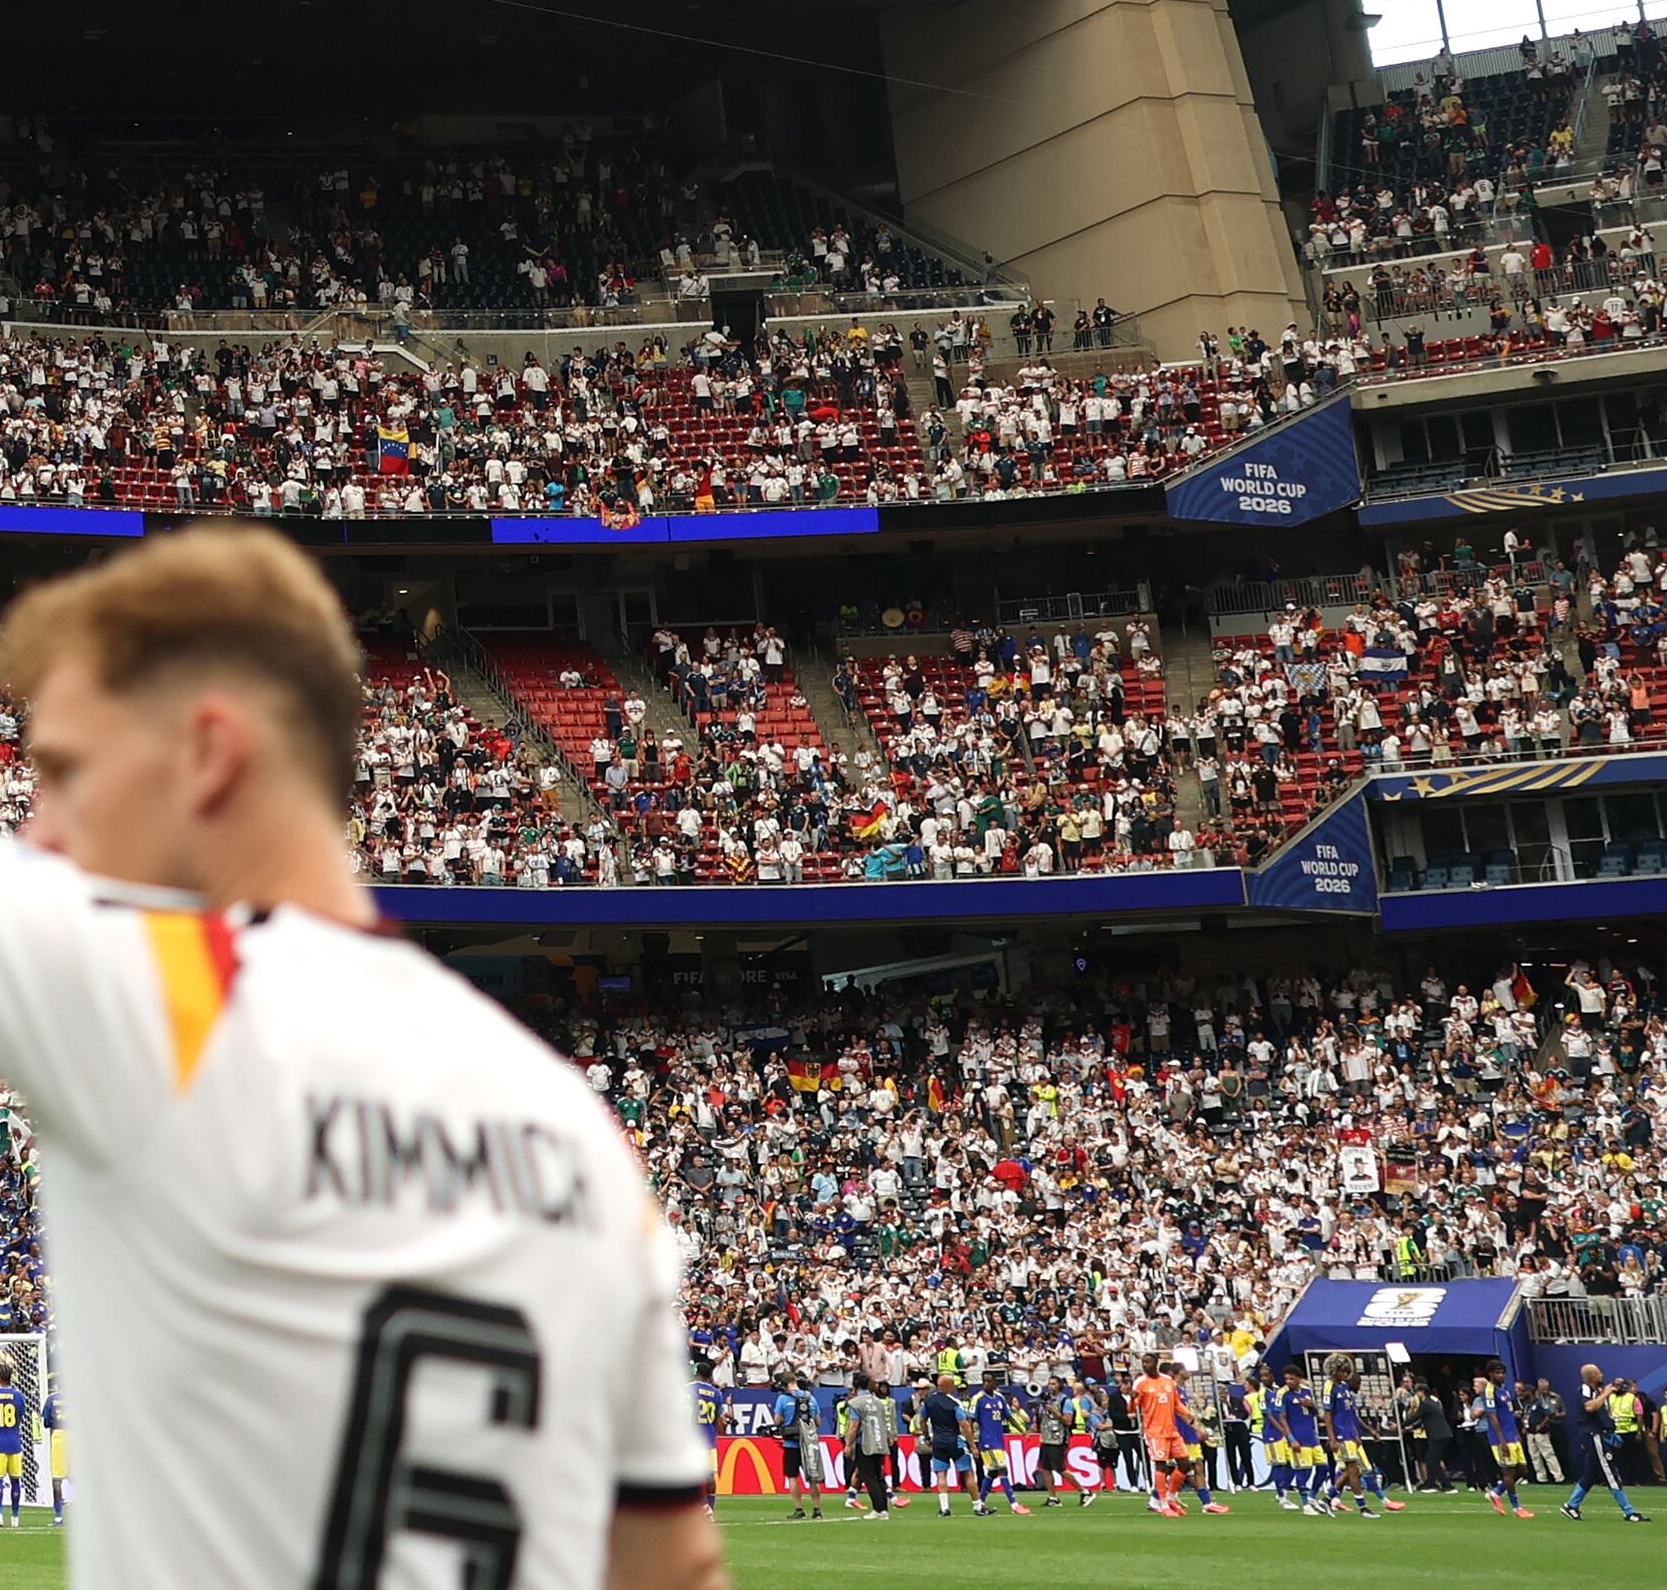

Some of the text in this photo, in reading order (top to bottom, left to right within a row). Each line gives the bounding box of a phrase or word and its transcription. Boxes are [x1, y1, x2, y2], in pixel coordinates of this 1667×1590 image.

[1244, 463, 1278, 479] FIFA
[1220, 477, 1307, 498] WORLD CUP
[1239, 495, 1292, 514] 2026
[1315, 844, 1339, 860] FIFA
[1300, 857, 1359, 878] WORLD CUP
[1314, 877, 1351, 894] 2026
[302, 1092, 592, 1230] KIMMIC
[698, 1400, 716, 1425] 20
[312, 1280, 543, 1590] 6
